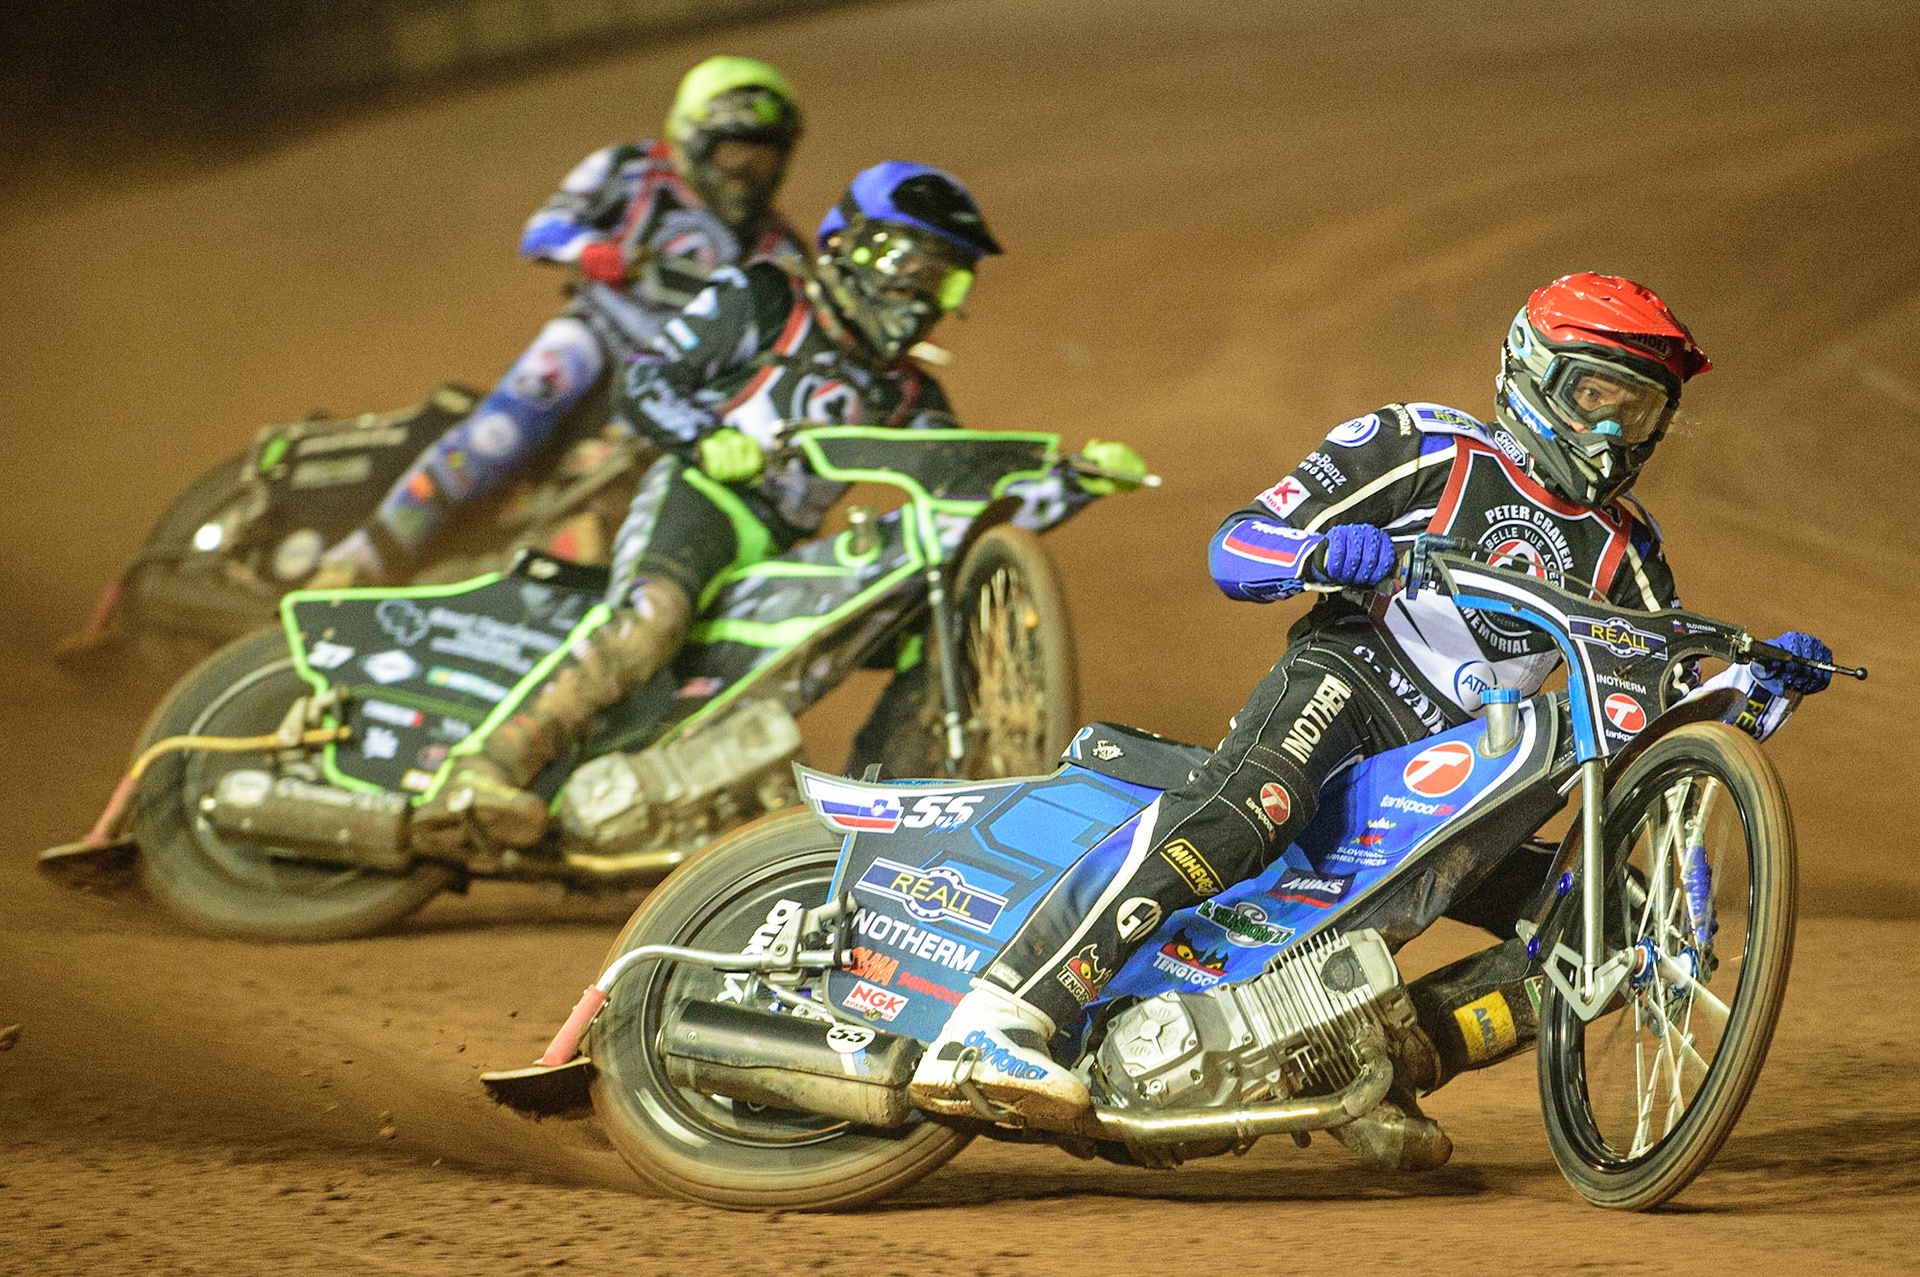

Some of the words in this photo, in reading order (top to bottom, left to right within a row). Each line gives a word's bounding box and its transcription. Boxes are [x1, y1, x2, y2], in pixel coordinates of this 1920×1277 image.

[1497, 432, 1523, 462] SHOEI
[1485, 505, 1531, 525] PETER
[1533, 511, 1575, 571] CRAVEN
[1485, 527, 1519, 550] BELLE
[1525, 529, 1546, 551] VUE
[1461, 606, 1531, 655] MEMORIAL
[1591, 624, 1650, 651] REALL
[1596, 673, 1647, 695] INOTHERM
[889, 872, 973, 918] REALL
[851, 985, 904, 1013] NGK
[964, 1030, 1048, 1080] daytona
